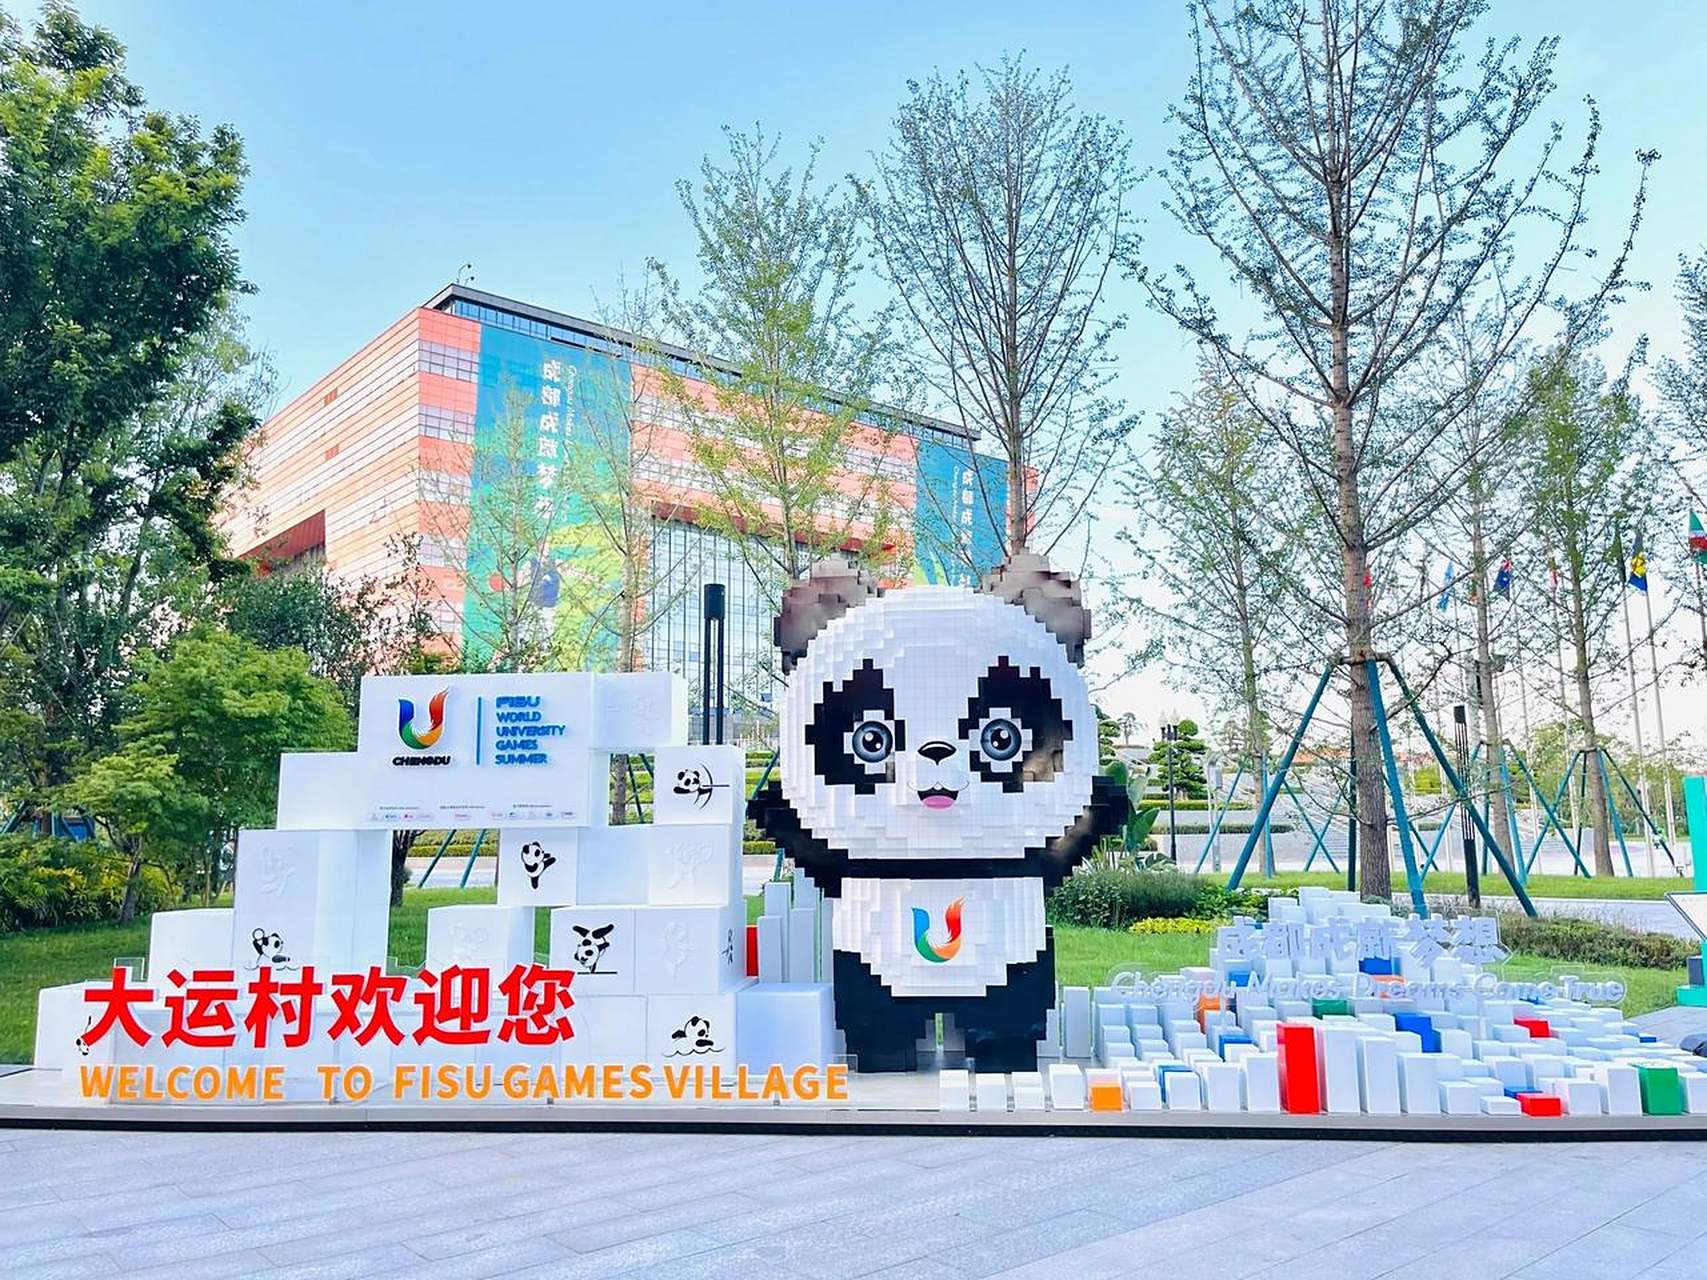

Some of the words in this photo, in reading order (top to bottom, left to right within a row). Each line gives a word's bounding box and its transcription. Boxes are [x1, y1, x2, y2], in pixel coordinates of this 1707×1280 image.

[496, 711, 542, 723] WORLD
[496, 725, 566, 737] UNIVERSITY
[495, 739, 539, 751] GAMES
[392, 755, 451, 766] CHENGDU
[495, 753, 548, 765] SUMMER
[1111, 971, 1237, 1004] Chengdu
[1246, 970, 1341, 999] Makes
[1353, 972, 1462, 1000] Dreams
[1473, 972, 1558, 1000] Come
[1558, 974, 1625, 1001] True
[82, 964, 575, 1048] 大运村欢迎您
[81, 1065, 285, 1099] WELCOME
[318, 1066, 372, 1100] TO
[394, 1065, 491, 1099] FISU
[503, 1065, 653, 1099] GAMES
[662, 1065, 848, 1099] VILLAGE
